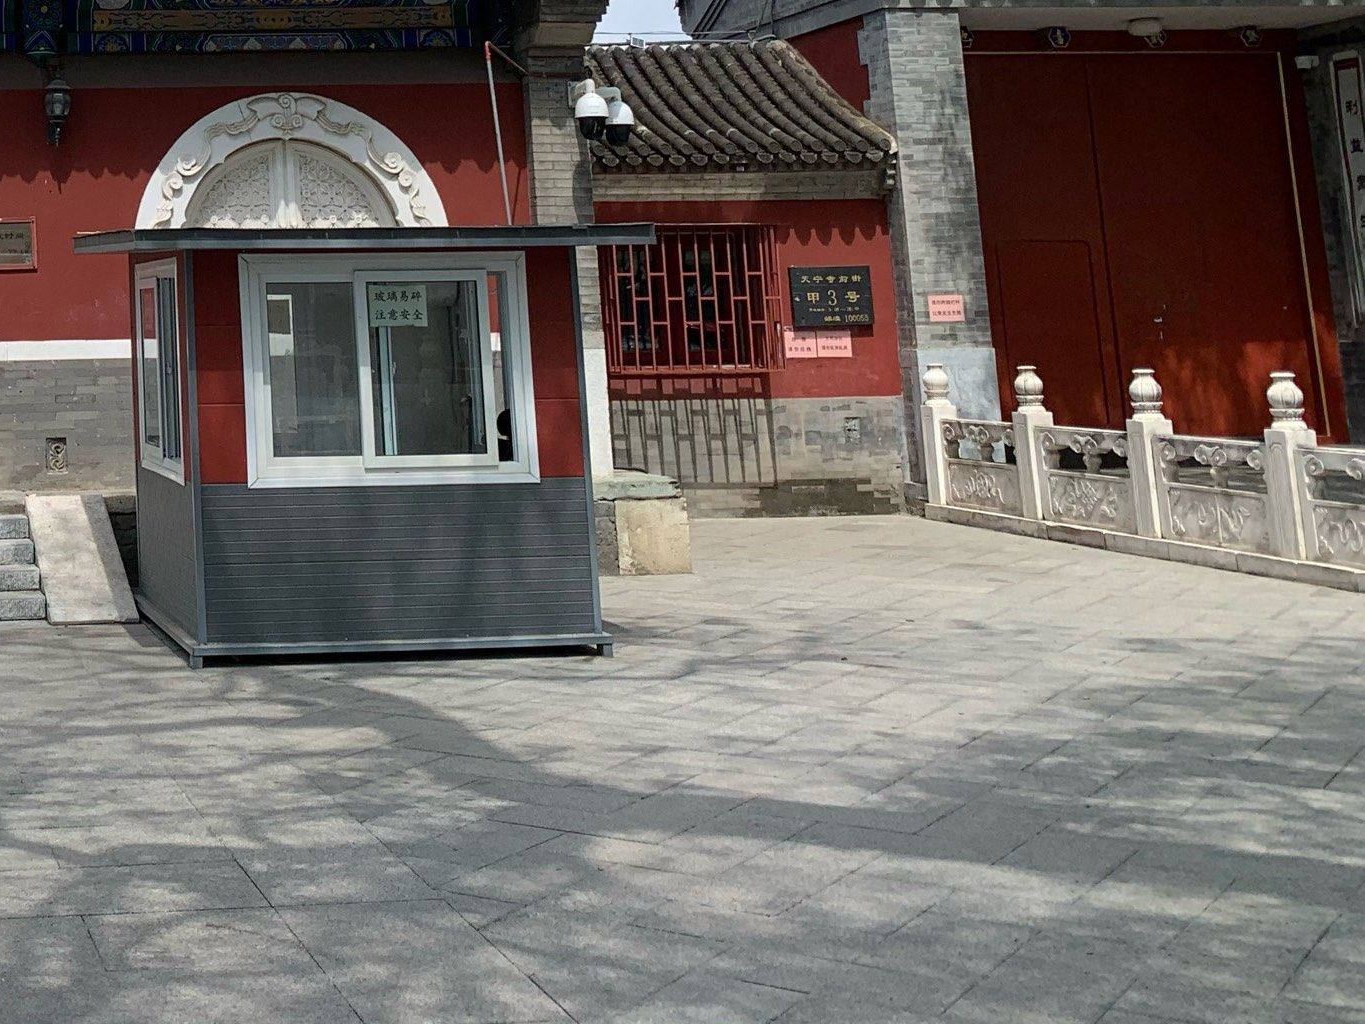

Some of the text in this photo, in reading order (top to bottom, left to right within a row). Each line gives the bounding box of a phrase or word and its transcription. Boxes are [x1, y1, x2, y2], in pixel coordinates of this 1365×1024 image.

[373, 290, 423, 302] 玻璃易碎
[374, 308, 424, 321] 注意安全
